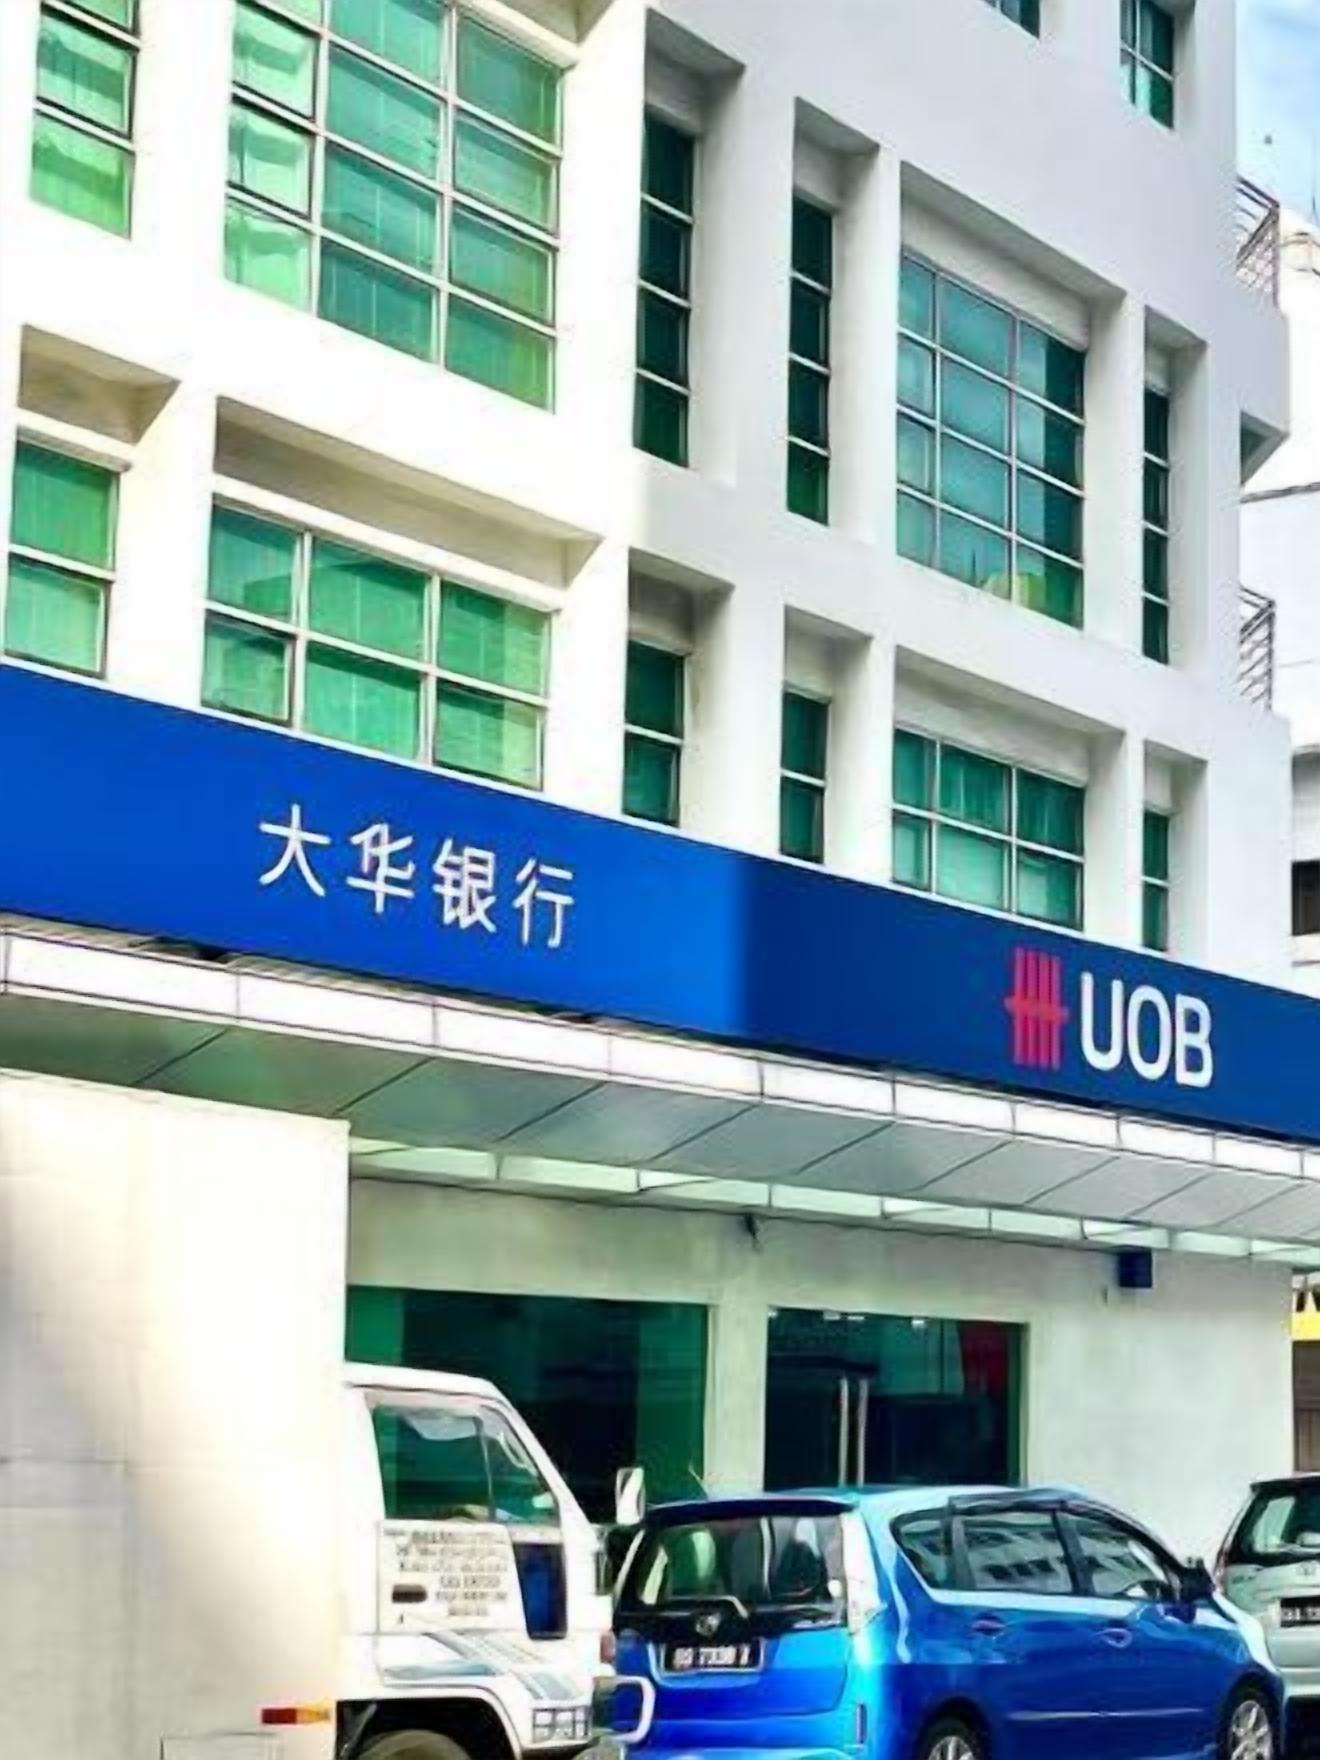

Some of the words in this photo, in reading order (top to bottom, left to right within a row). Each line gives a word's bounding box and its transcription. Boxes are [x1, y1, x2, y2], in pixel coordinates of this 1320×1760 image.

[258, 803, 575, 949] 大华银行
[1080, 971, 1214, 1088] UOB
